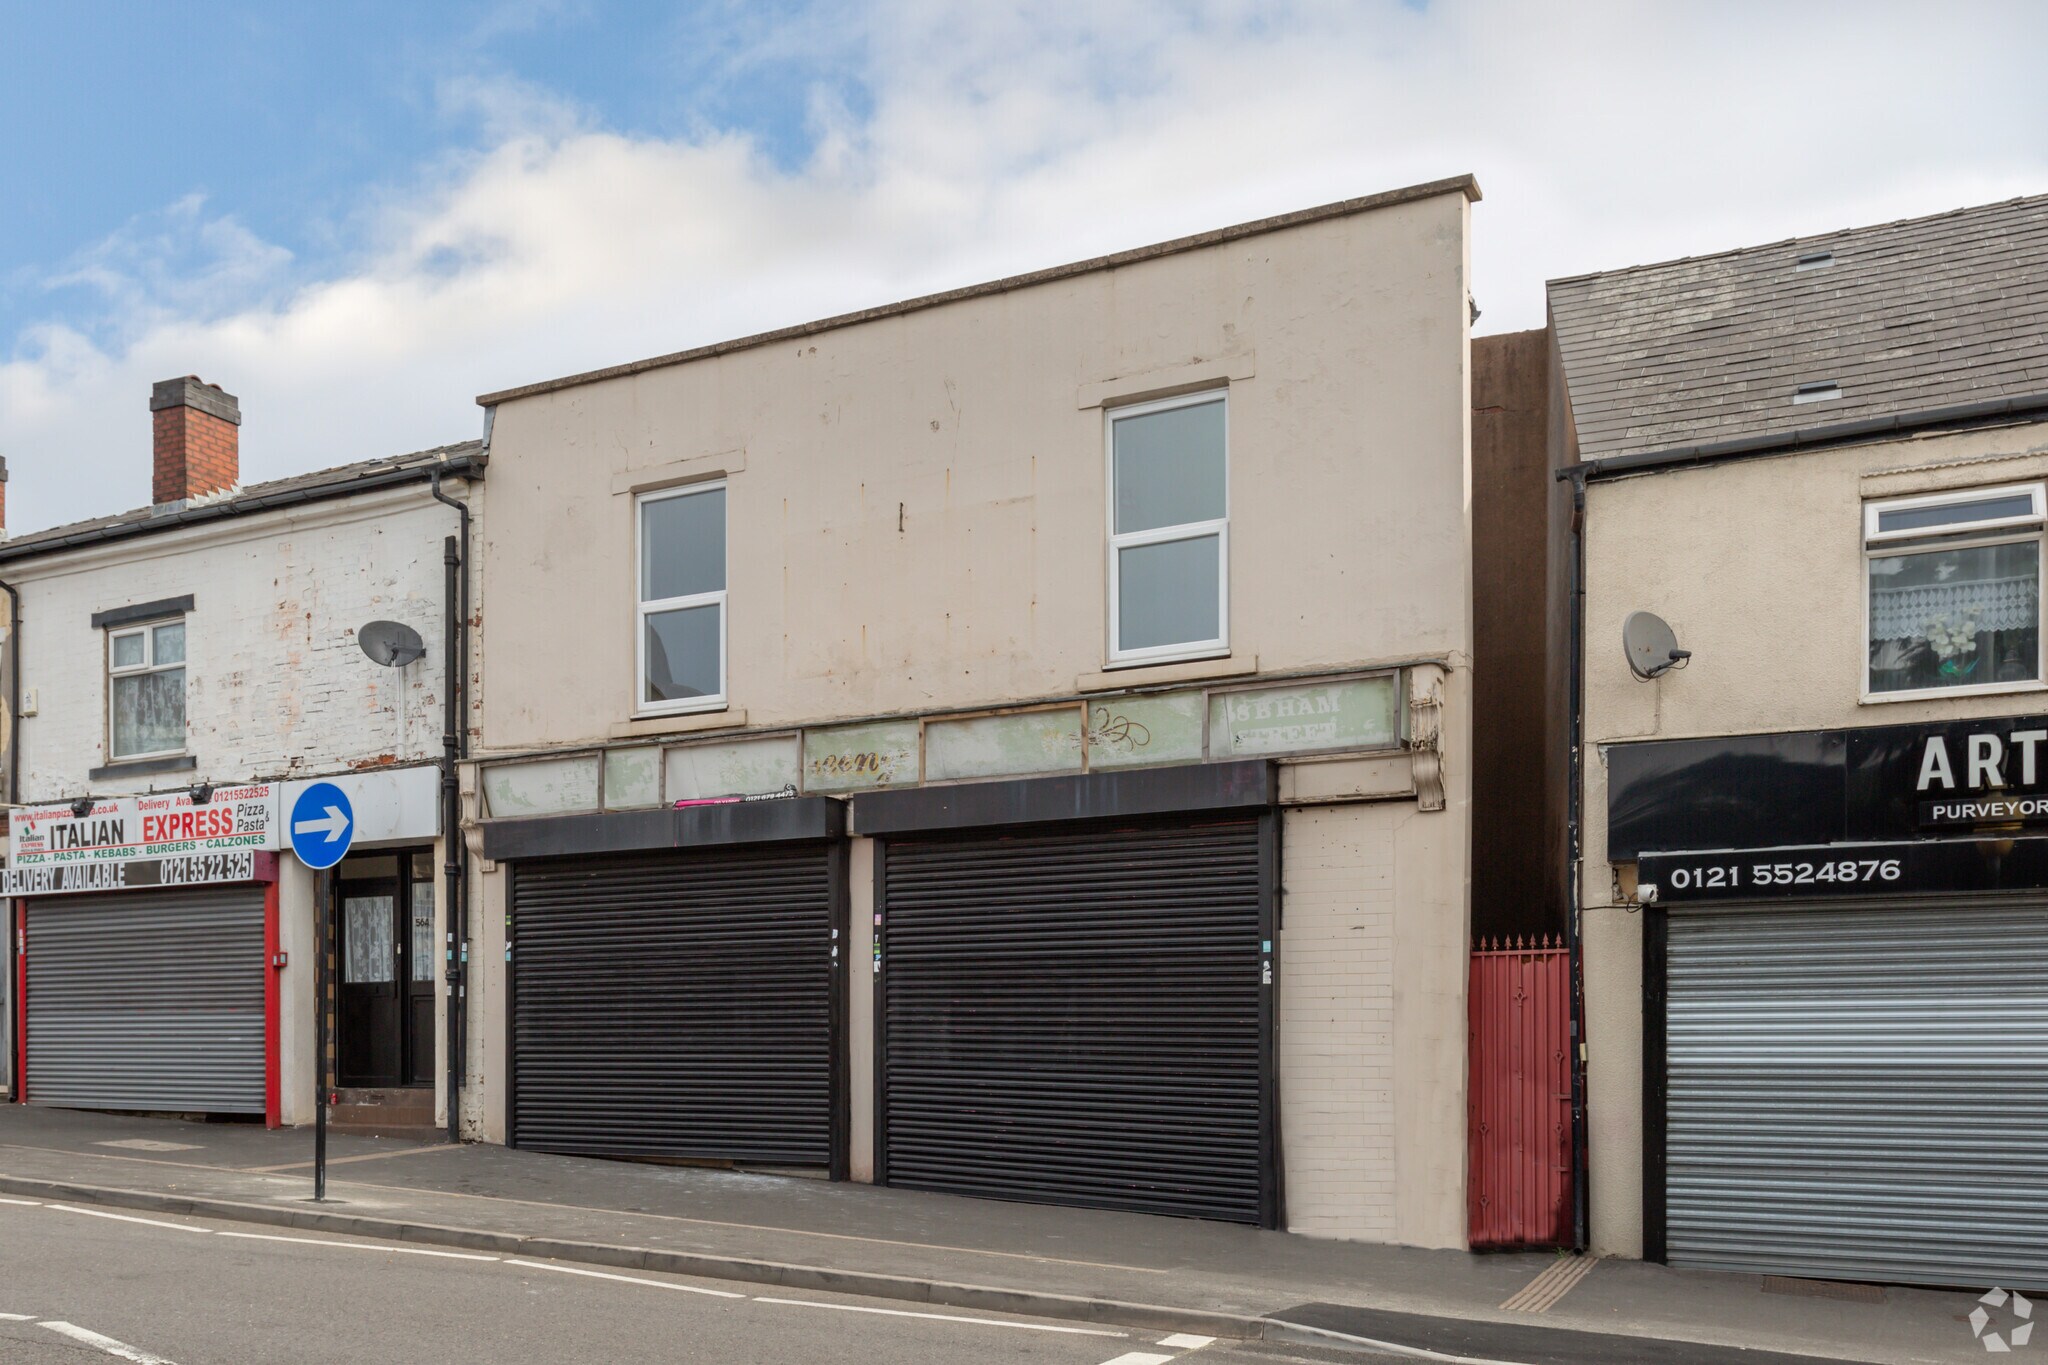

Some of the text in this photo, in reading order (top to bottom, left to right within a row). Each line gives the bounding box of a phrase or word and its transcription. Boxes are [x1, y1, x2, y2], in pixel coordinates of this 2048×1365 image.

[1916, 729, 2047, 791] ART
[214, 786, 270, 802] 01215522525
[138, 799, 170, 811] Delivery
[236, 803, 265, 817] Pizza
[1932, 799, 2048, 820] PURVEYOR
[50, 819, 124, 849] ITALIAN
[143, 807, 233, 842] EXPRESS
[236, 819, 265, 833] Pasta
[16, 834, 266, 864] PIZZA PASTA KEBABS BURGERS CALZONES
[19, 834, 45, 843] Italian
[2, 867, 55, 893] DELIVERY
[61, 862, 126, 890] AVAILABLE
[1670, 859, 1901, 889] 0121 5524876
[415, 918, 430, 928] 564
